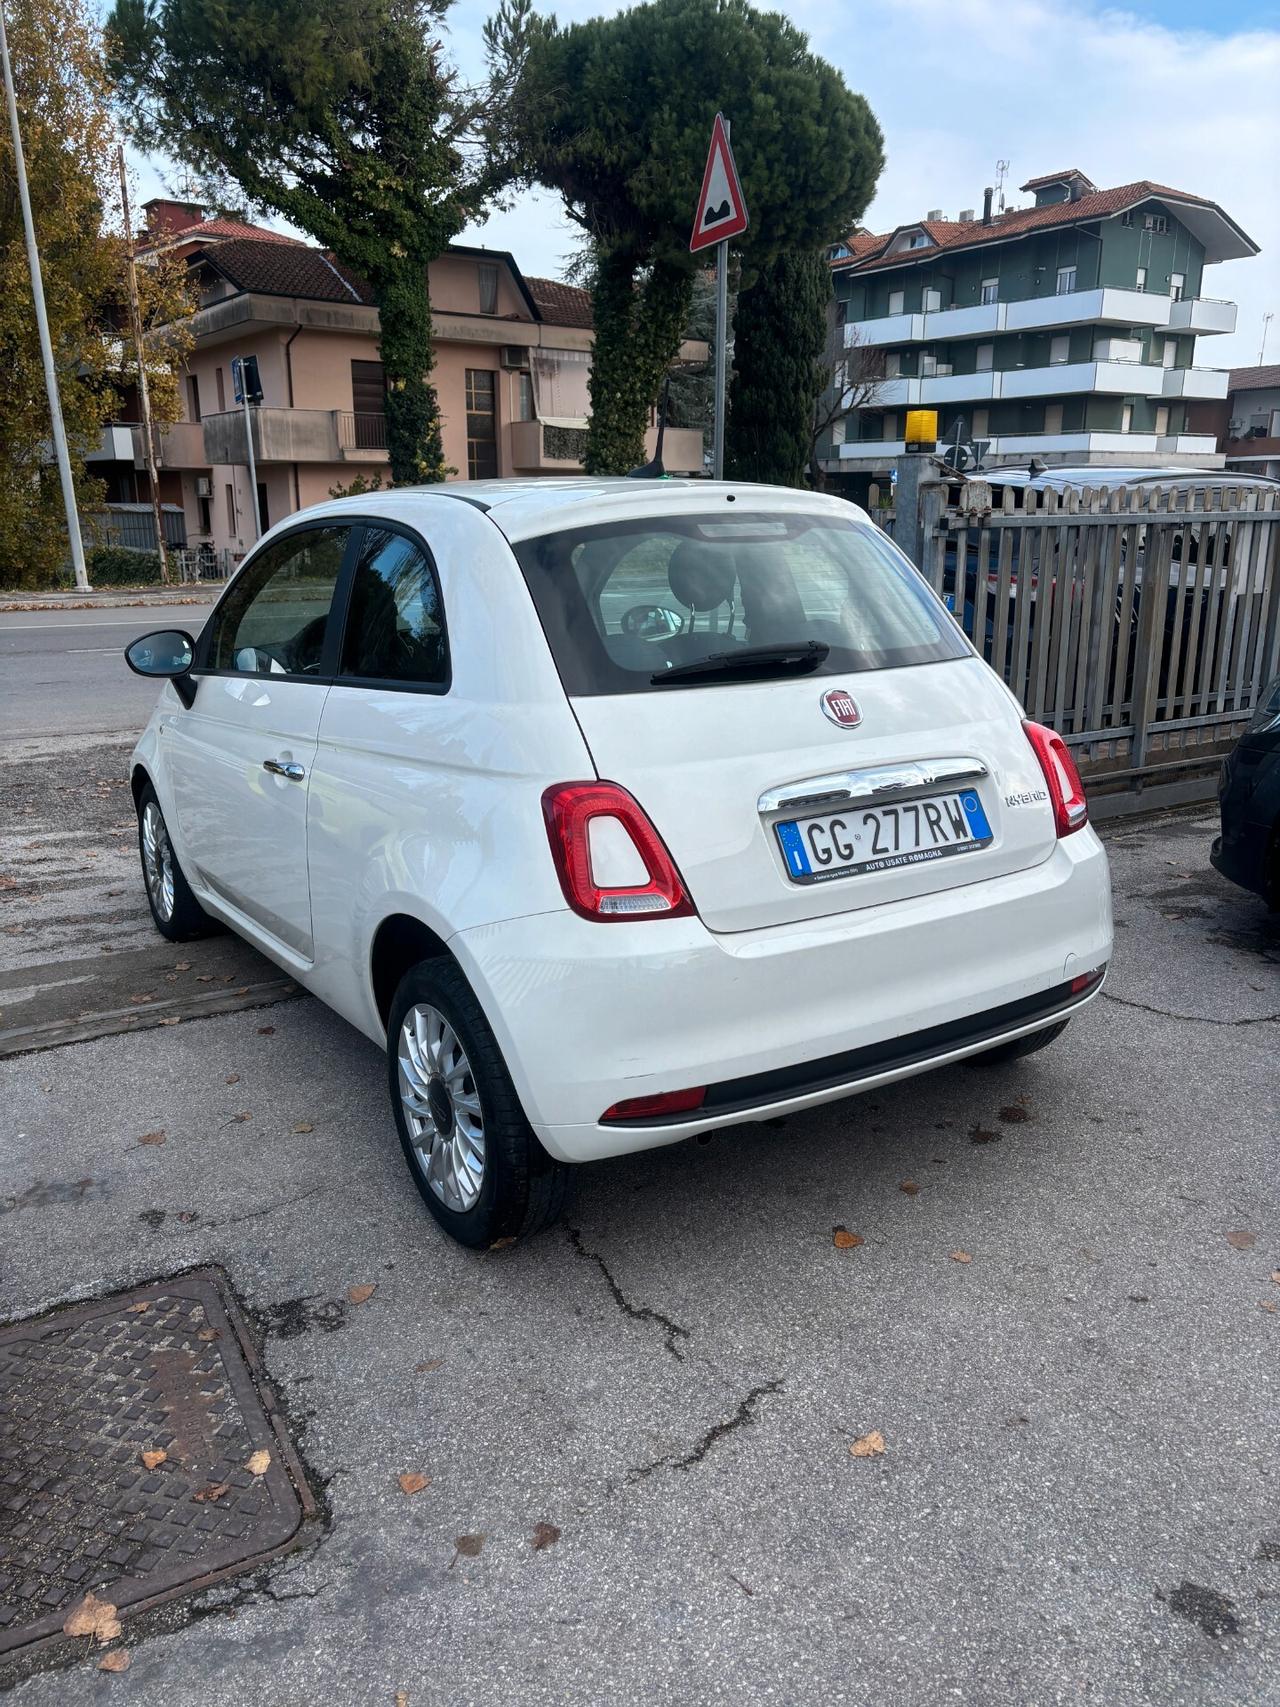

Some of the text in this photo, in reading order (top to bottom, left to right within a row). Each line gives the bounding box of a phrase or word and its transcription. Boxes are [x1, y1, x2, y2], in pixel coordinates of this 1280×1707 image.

[831, 698, 856, 717] FIAT
[1005, 790, 1047, 808] HYBRID
[866, 849, 943, 871] AUTO USATE ROMAGNA
